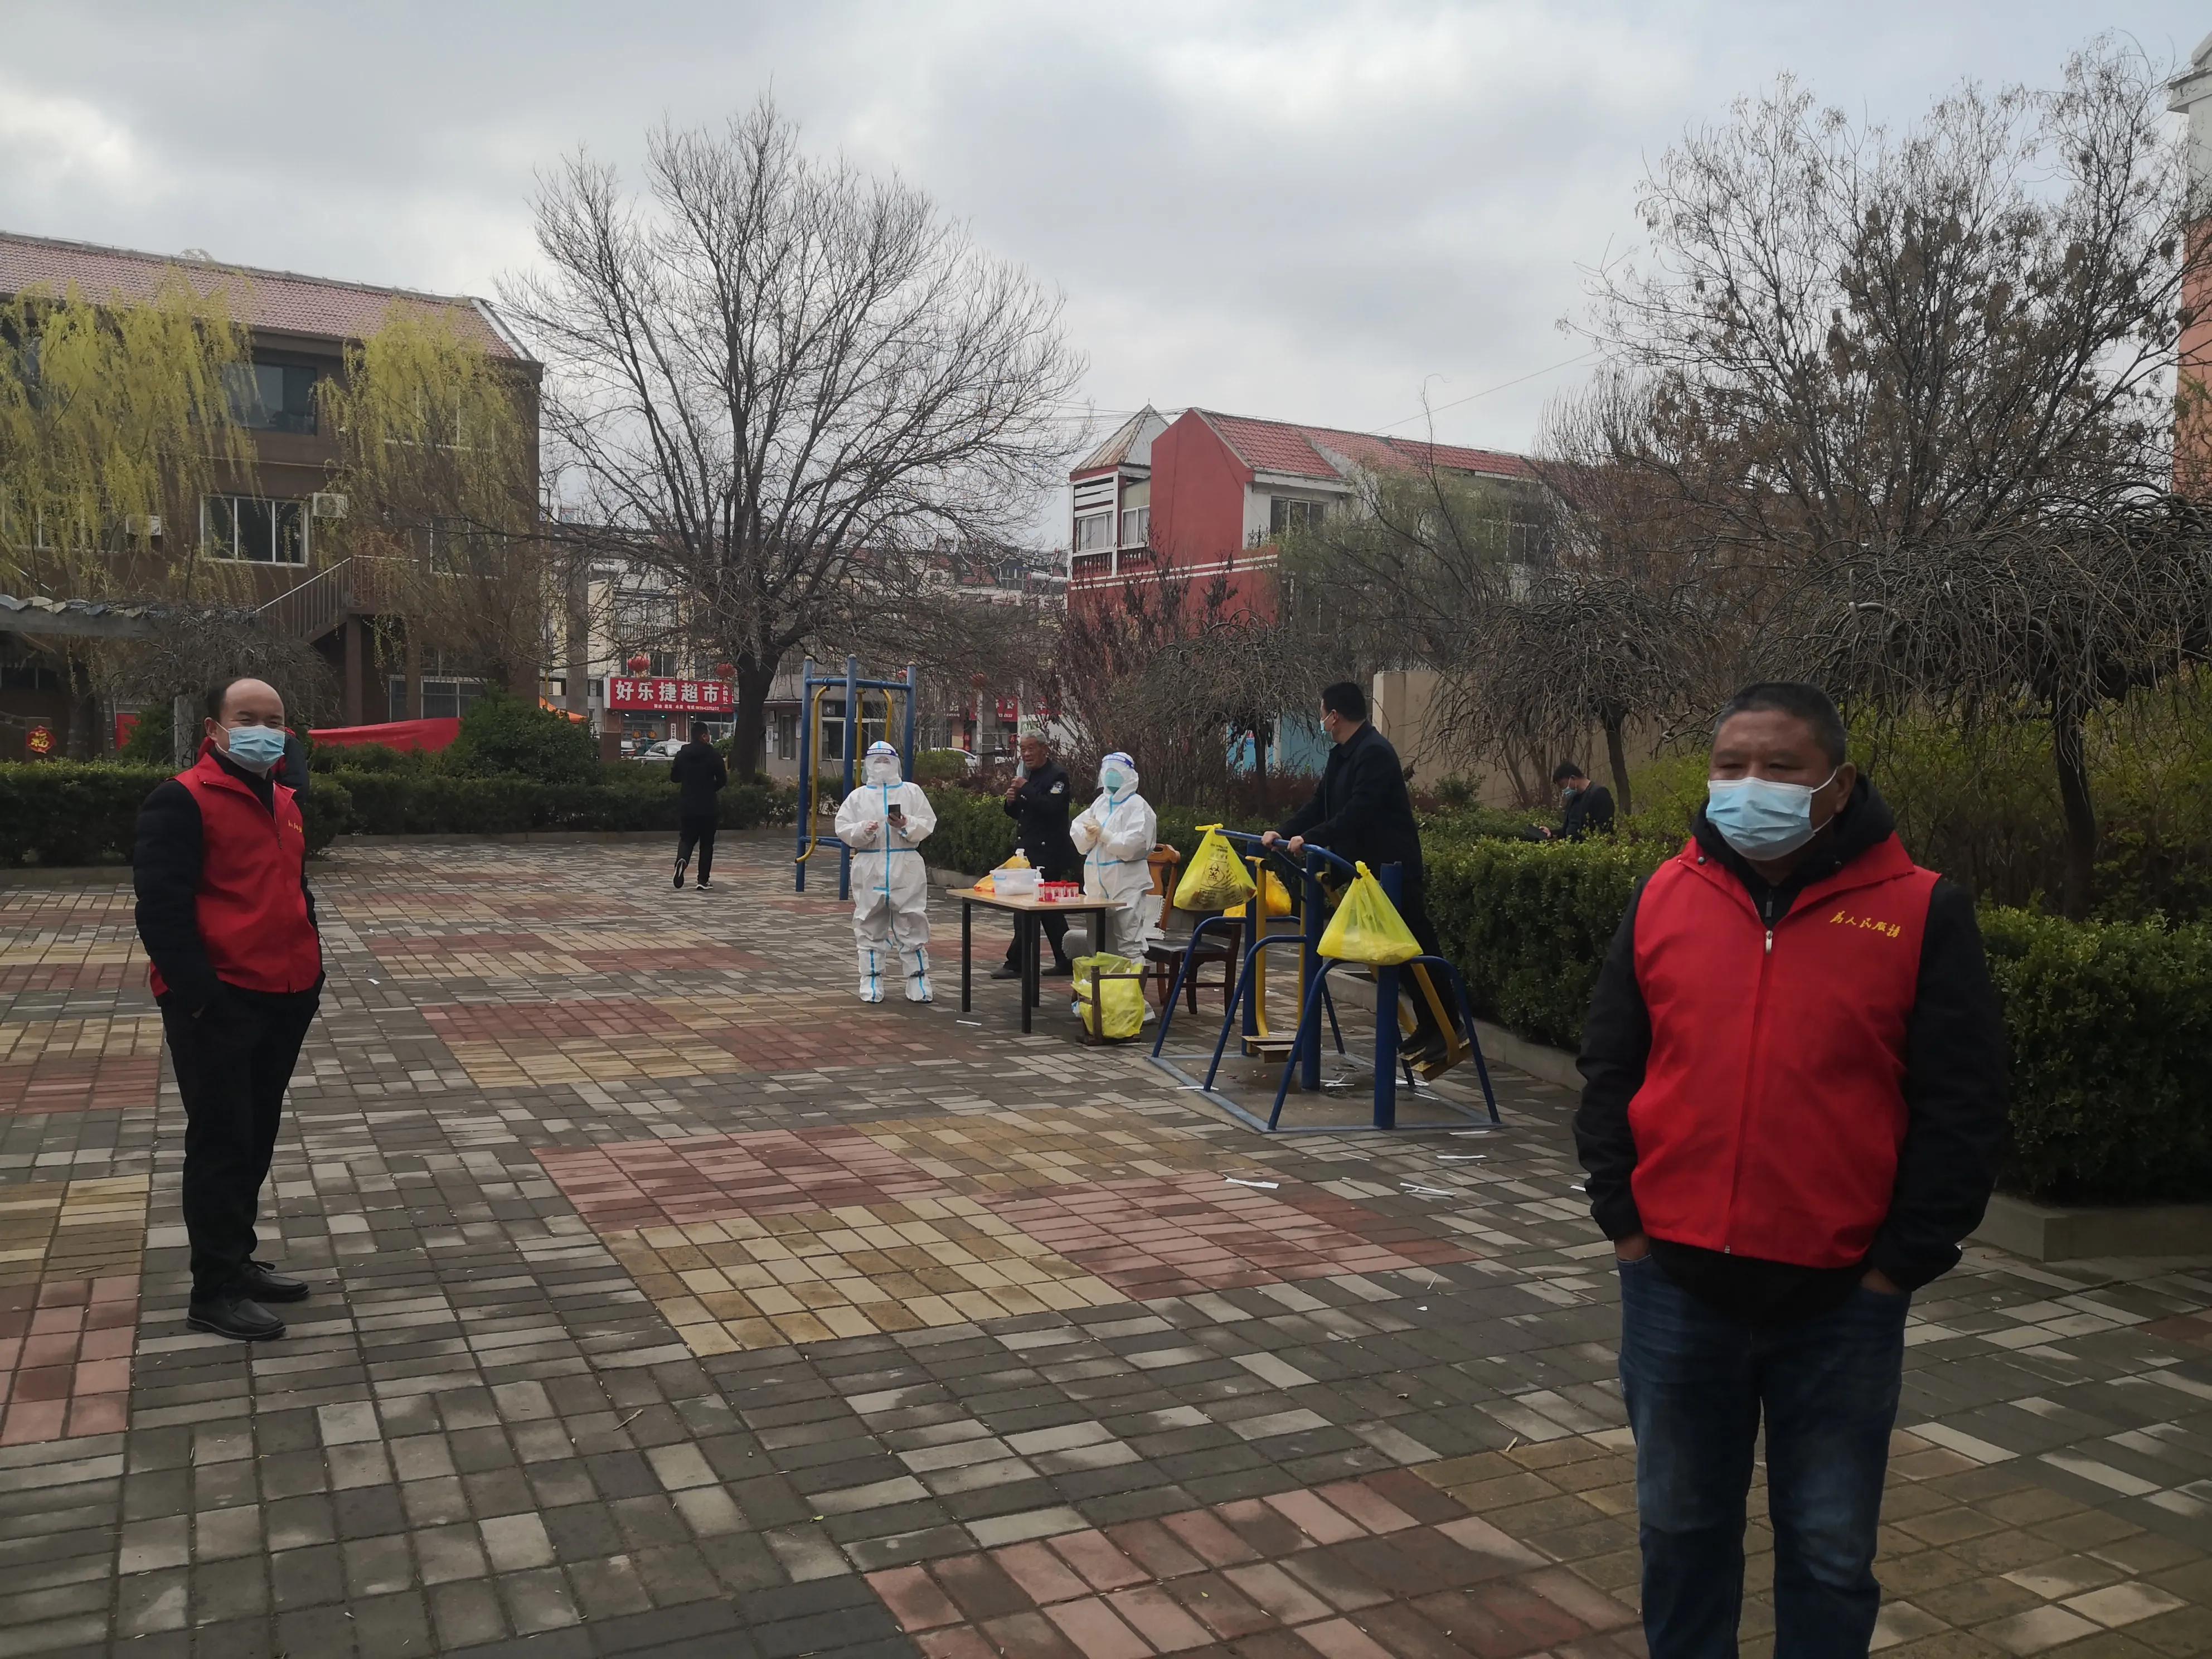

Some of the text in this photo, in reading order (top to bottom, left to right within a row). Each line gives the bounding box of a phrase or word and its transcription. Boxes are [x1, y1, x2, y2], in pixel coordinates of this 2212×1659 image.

[615, 680, 719, 704] 好乐捷超市
[31, 732, 49, 748] 福
